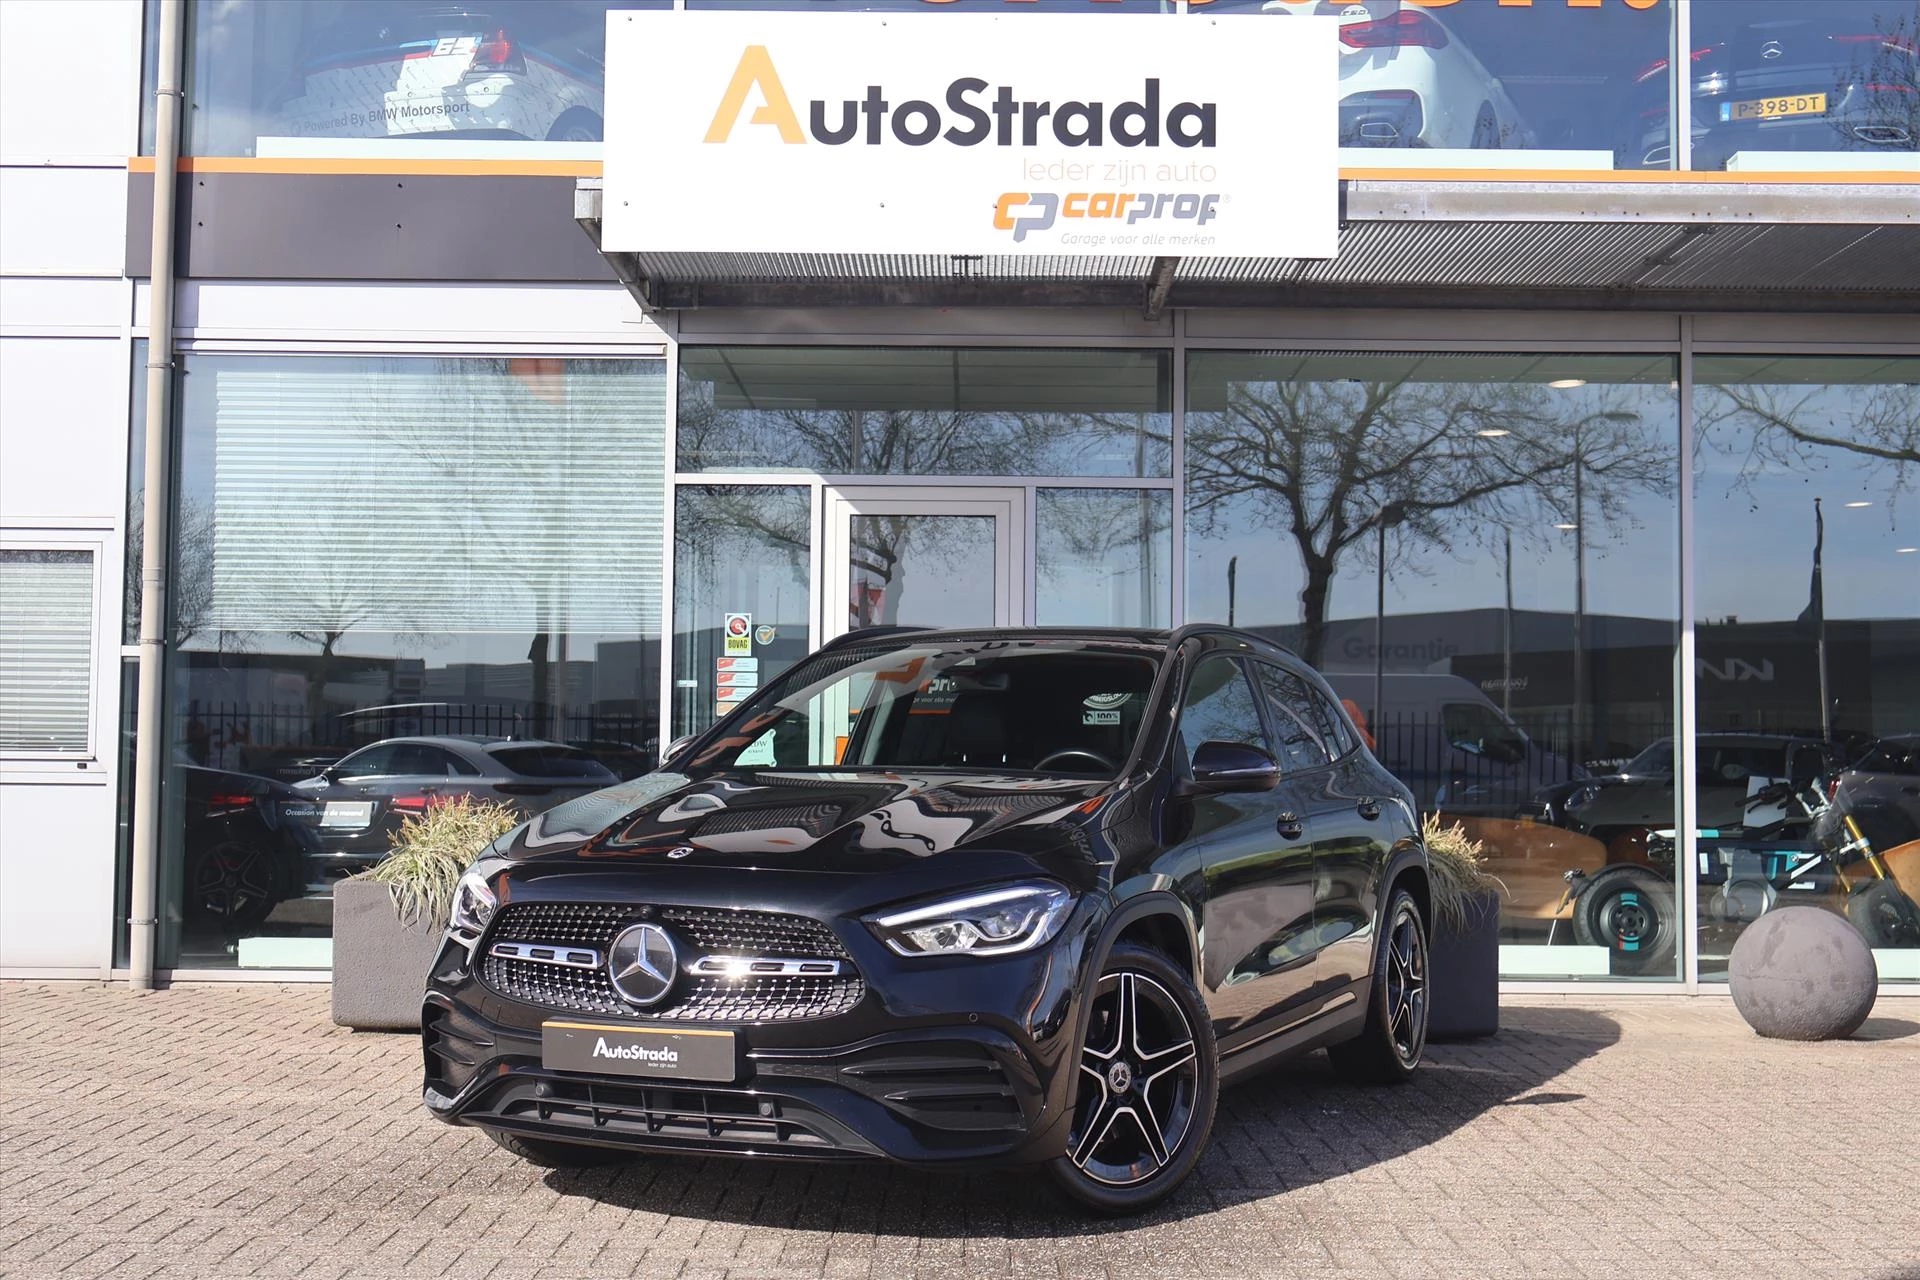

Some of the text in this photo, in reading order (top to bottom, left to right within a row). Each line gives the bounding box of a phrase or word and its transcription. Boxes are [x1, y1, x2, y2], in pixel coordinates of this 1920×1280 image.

[702, 45, 1217, 147] AutoStrada
[1737, 96, 1820, 118] P-398-DT
[304, 102, 471, 133] Powered By BMW Motorsport
[1023, 158, 1217, 187] Ieder zijn auto
[1062, 192, 1221, 226] carprof
[1061, 233, 1216, 247] Garage voor alle merken
[727, 639, 748, 650] BOVAG
[592, 1036, 679, 1062] AutoStrada
